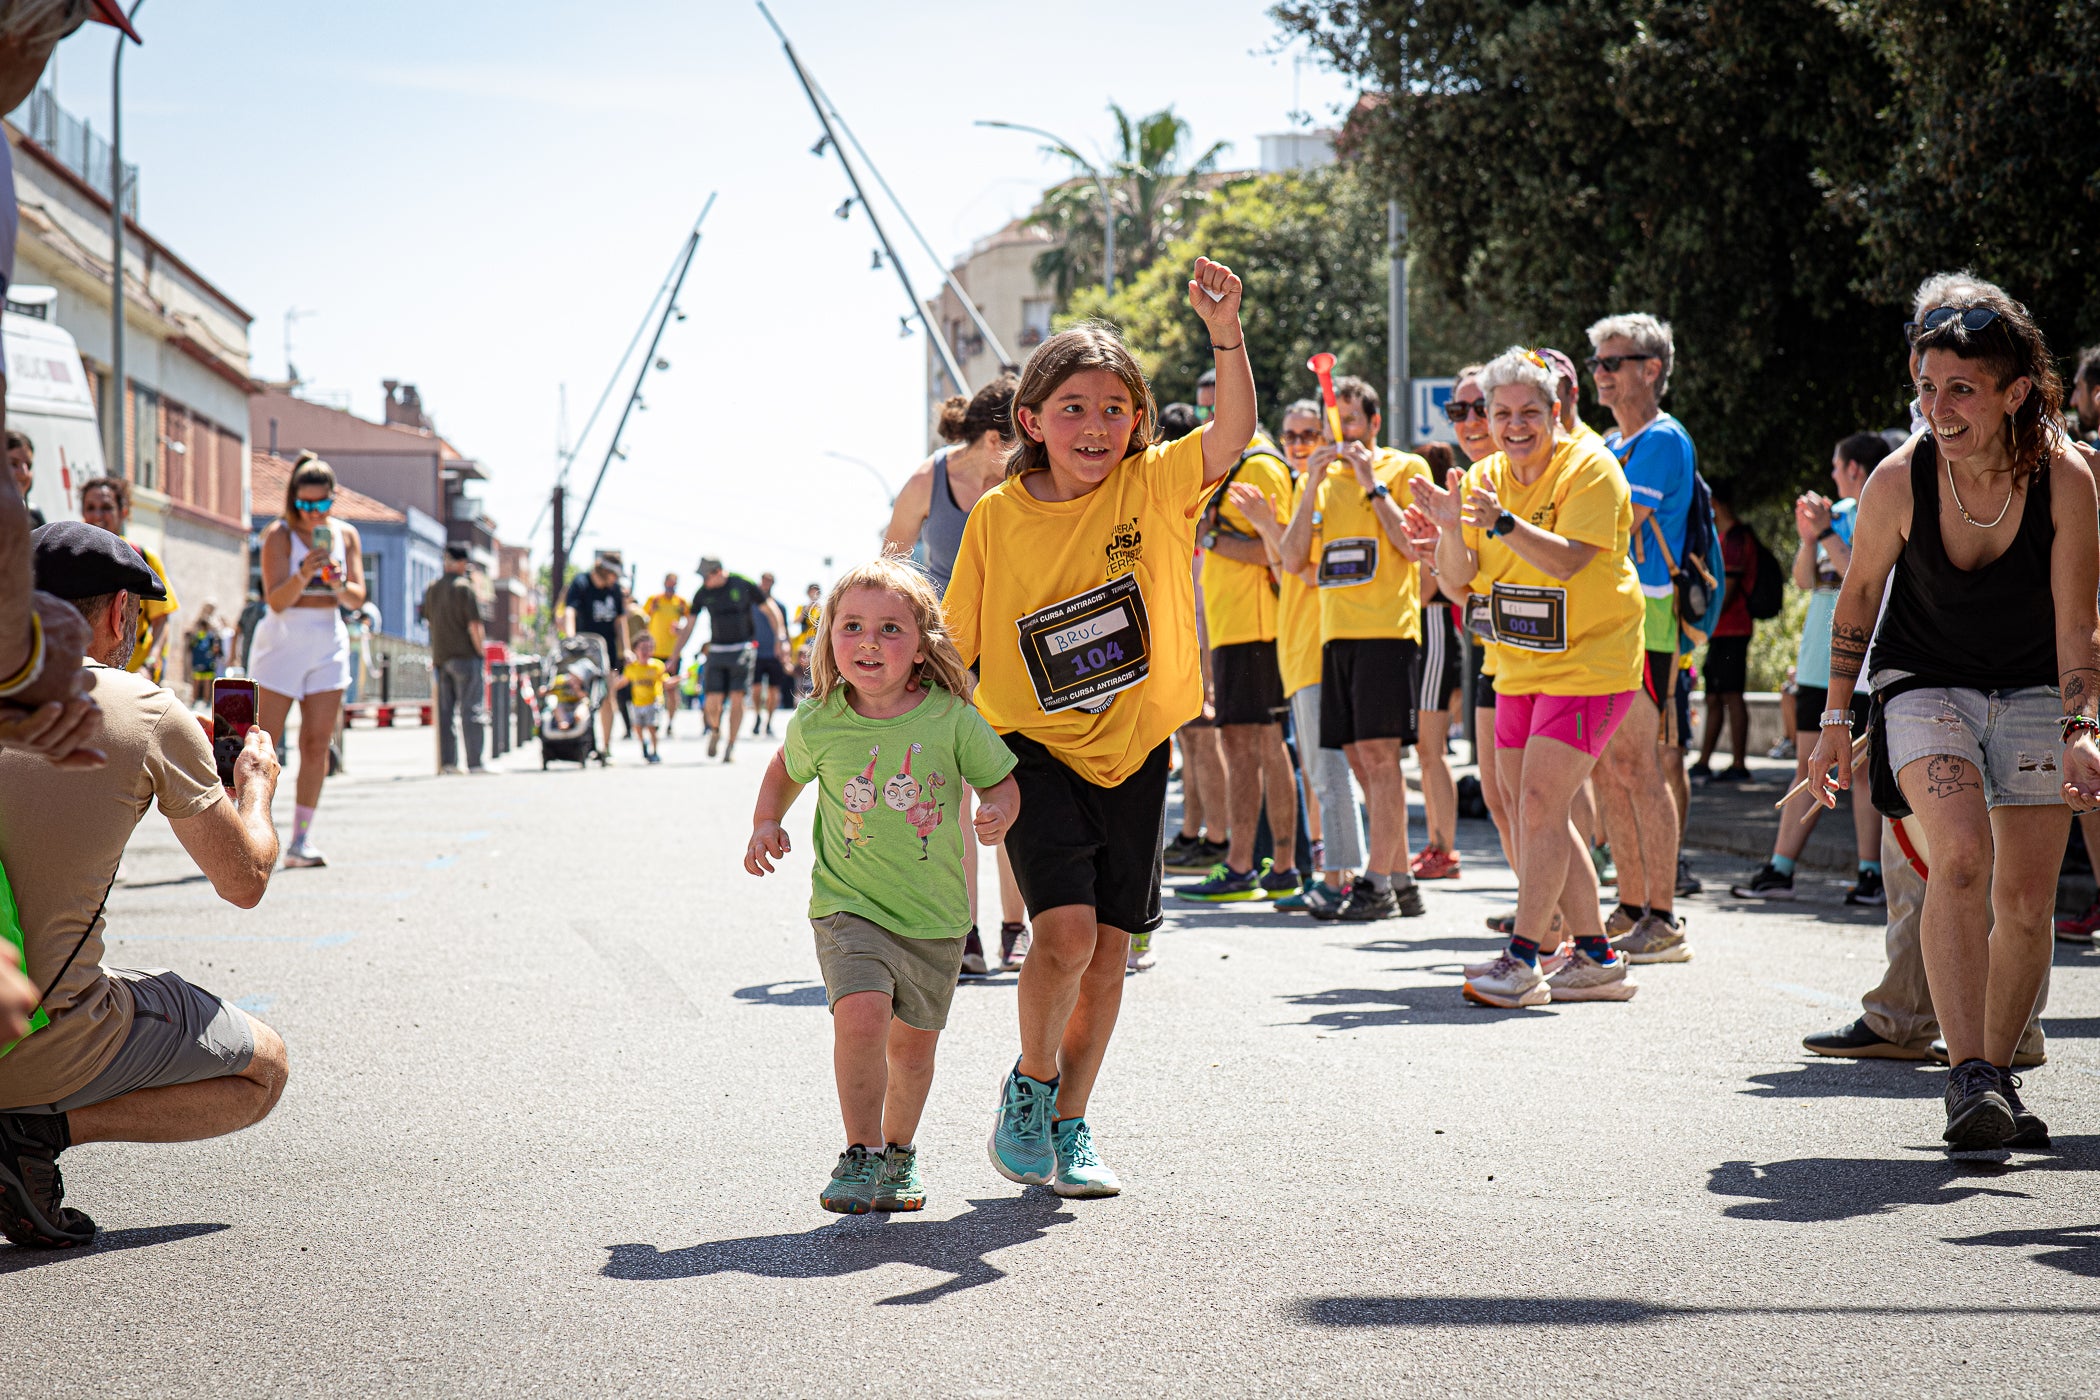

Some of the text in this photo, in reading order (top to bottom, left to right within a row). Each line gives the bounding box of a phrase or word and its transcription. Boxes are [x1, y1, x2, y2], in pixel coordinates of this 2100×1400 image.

[1040, 609, 1065, 623] CURSA
[1508, 618, 1539, 635] 001
[1054, 623, 1104, 653] BRUC
[1071, 641, 1125, 676] 104
[1069, 686, 1095, 700] CURSA
